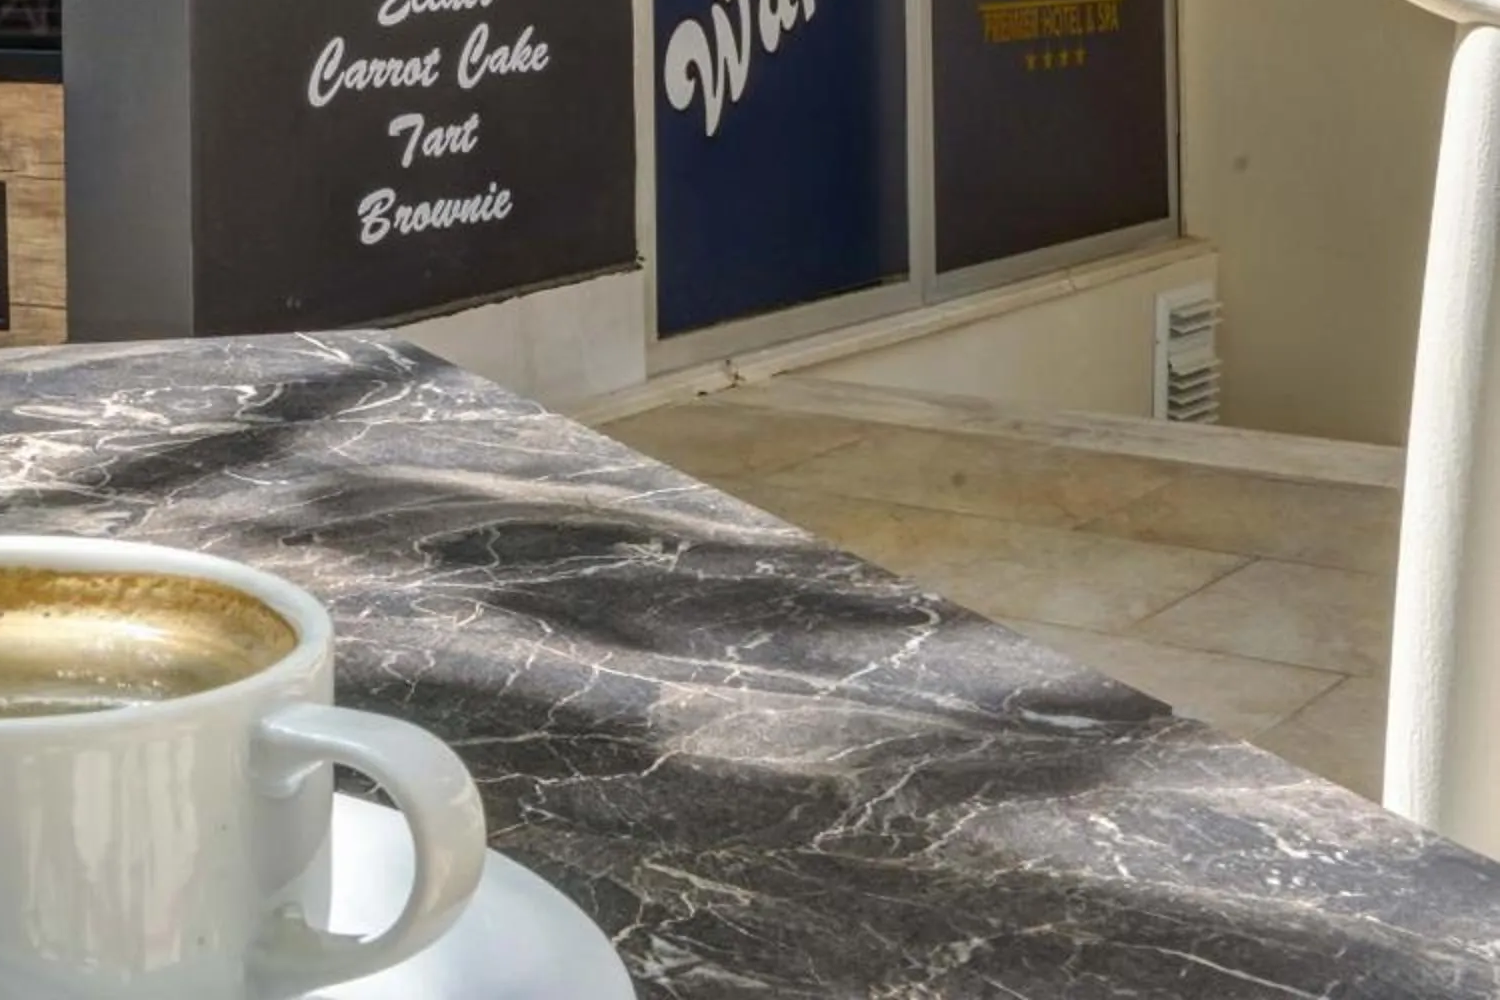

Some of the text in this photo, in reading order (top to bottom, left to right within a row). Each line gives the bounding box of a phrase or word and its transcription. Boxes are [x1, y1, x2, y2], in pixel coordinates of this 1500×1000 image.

[308, 22, 550, 107] Carrot Cake
[388, 113, 480, 168] Tart
[357, 182, 513, 245] Brownie
